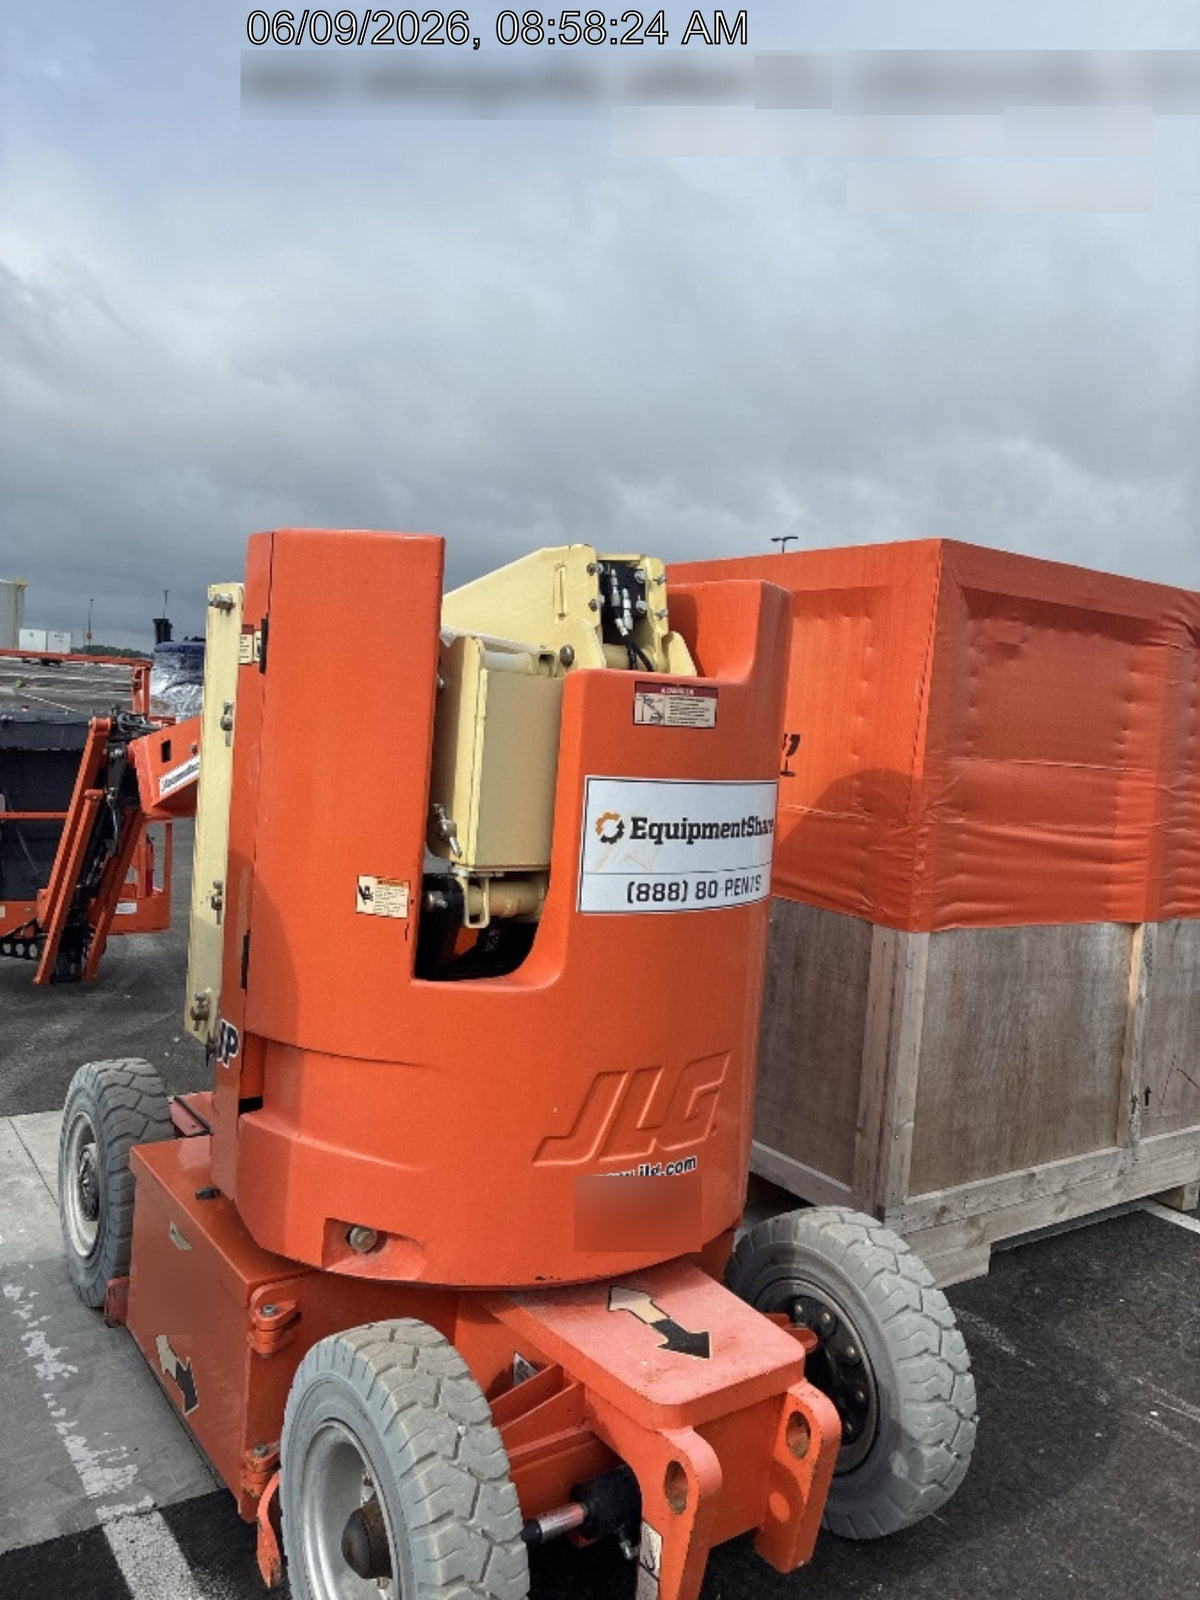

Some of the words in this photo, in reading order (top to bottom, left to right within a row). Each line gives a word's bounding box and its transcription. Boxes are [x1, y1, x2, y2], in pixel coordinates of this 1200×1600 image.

[629, 816, 775, 845] EquipmentShar
[627, 880, 688, 903] (888)
[532, 1050, 731, 1166] JLG
